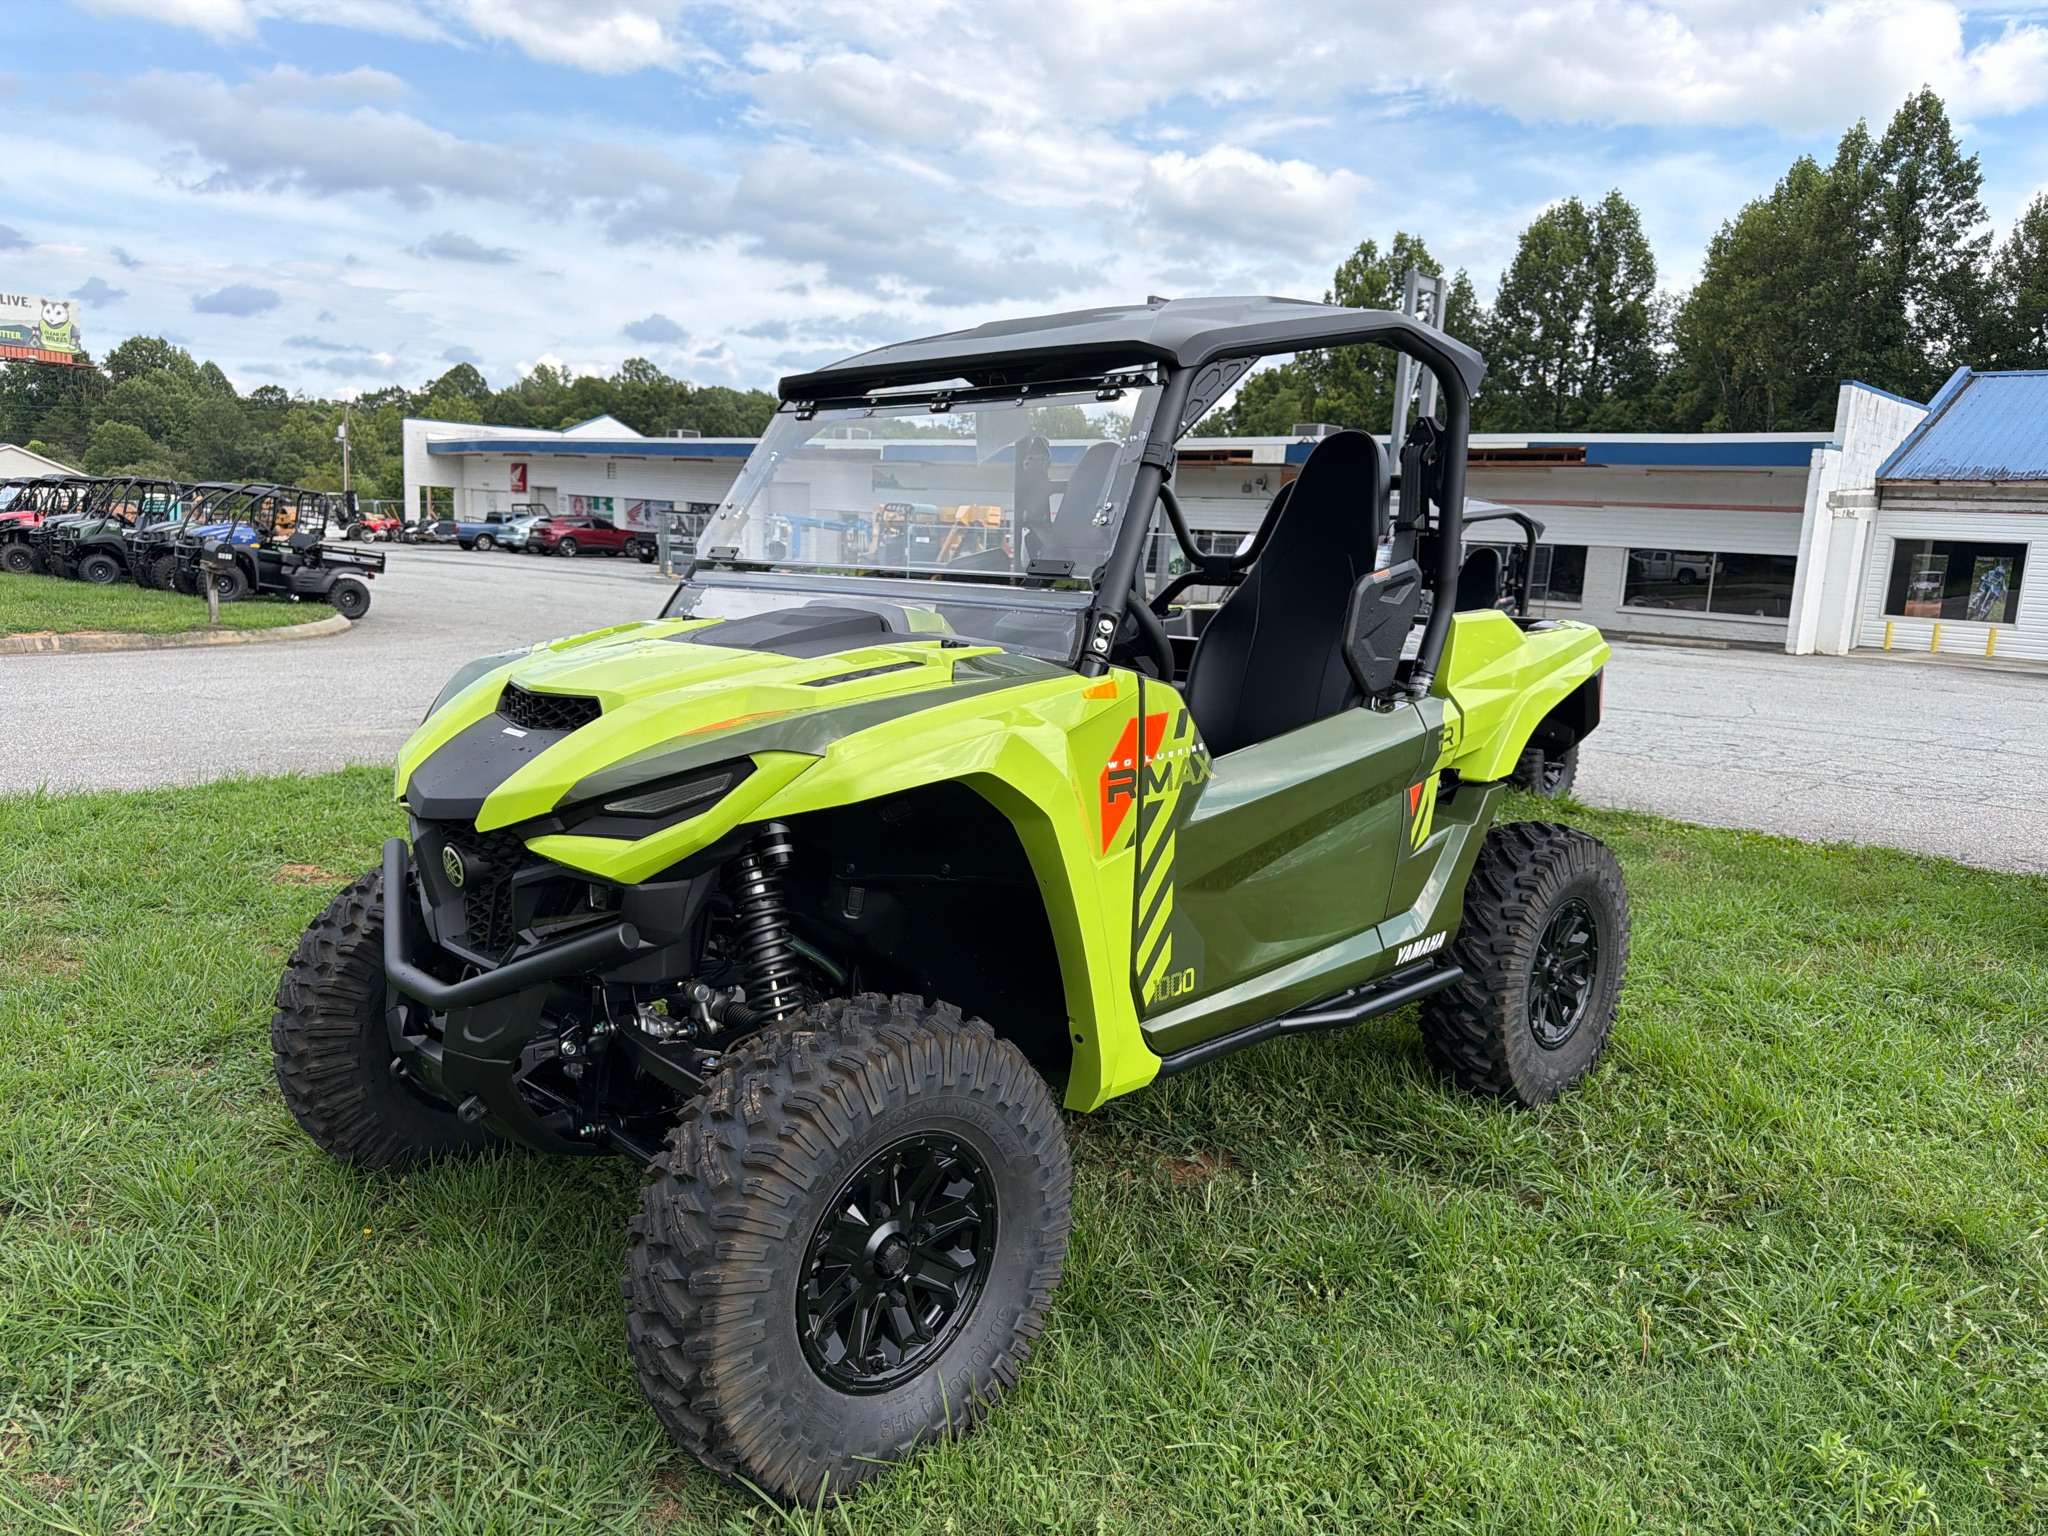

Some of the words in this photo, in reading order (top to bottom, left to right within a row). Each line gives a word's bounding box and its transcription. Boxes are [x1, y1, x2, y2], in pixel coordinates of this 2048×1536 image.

[1107, 752, 1218, 804] RMAX
[1395, 930, 1447, 966] YAMAHA
[1153, 967, 1195, 1003] 1000
[880, 1408, 916, 1438] NHS
